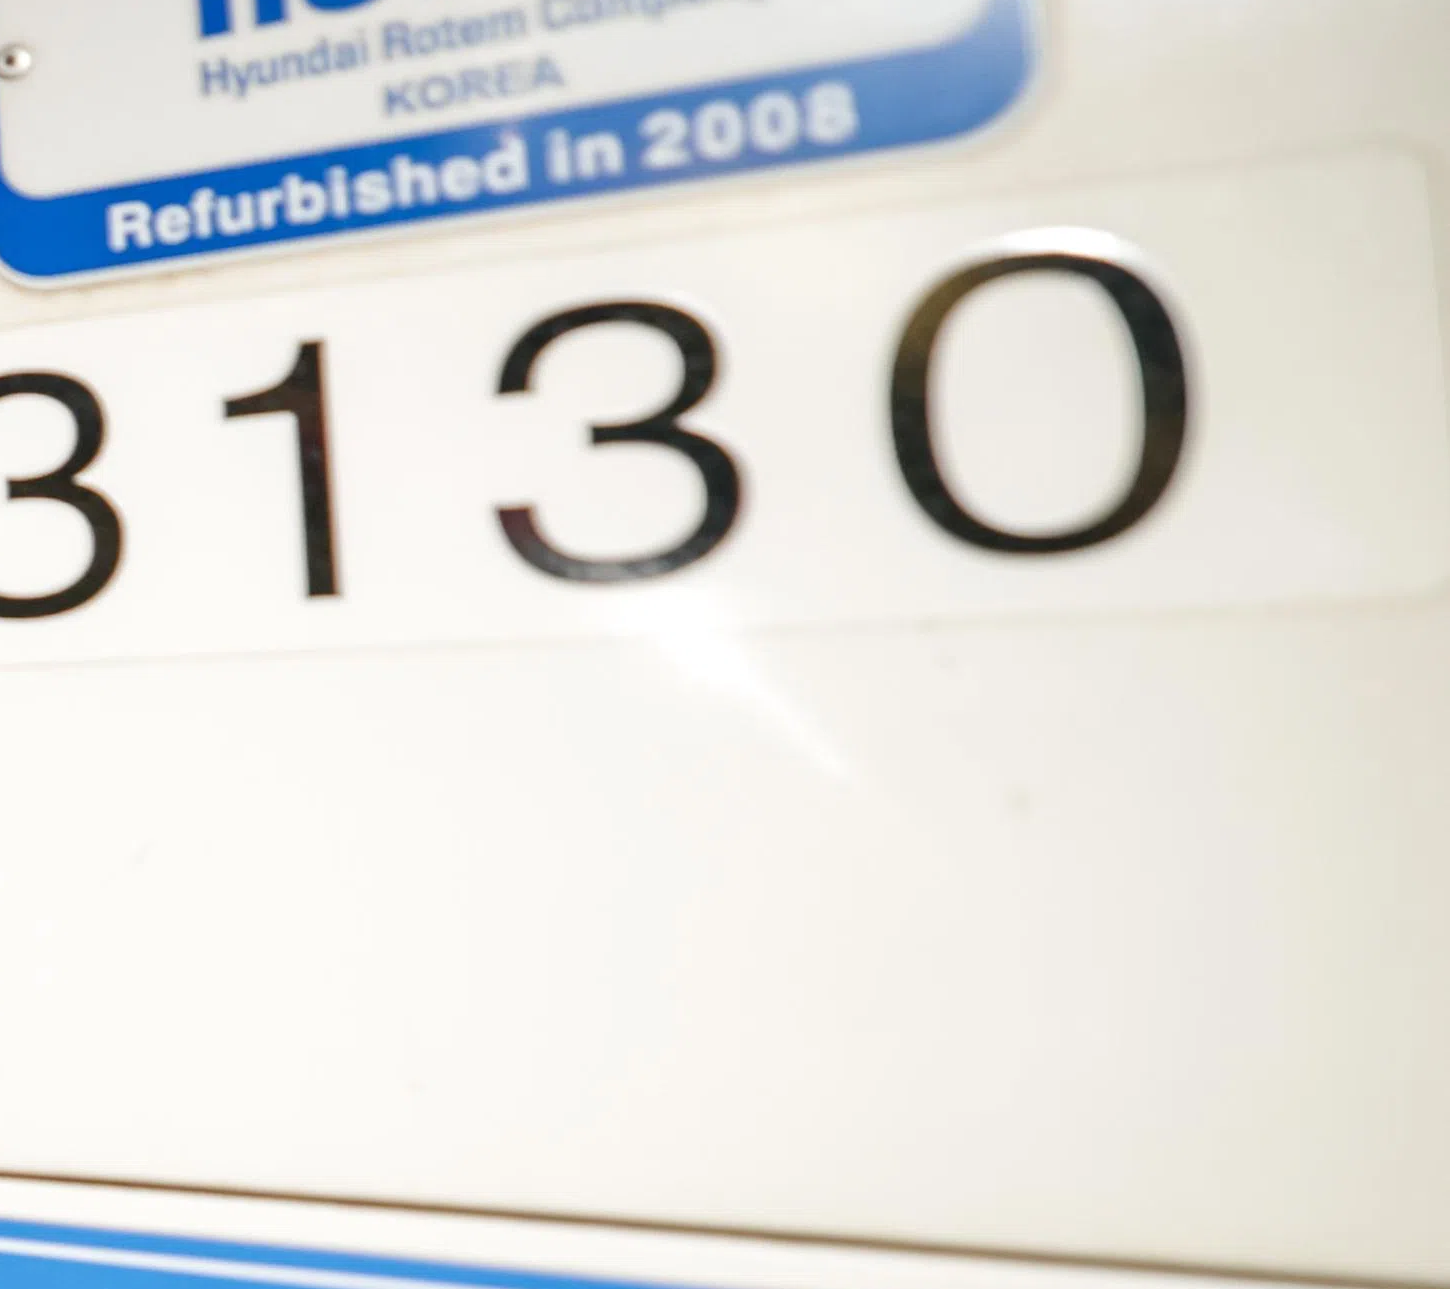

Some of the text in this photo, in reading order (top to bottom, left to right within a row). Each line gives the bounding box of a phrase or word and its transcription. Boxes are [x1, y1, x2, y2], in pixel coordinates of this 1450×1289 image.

[198, 37, 369, 98] Hyundai
[380, 9, 526, 60] Rotem
[383, 57, 564, 117] KOREA
[108, 80, 859, 250] Refurbished in 2008
